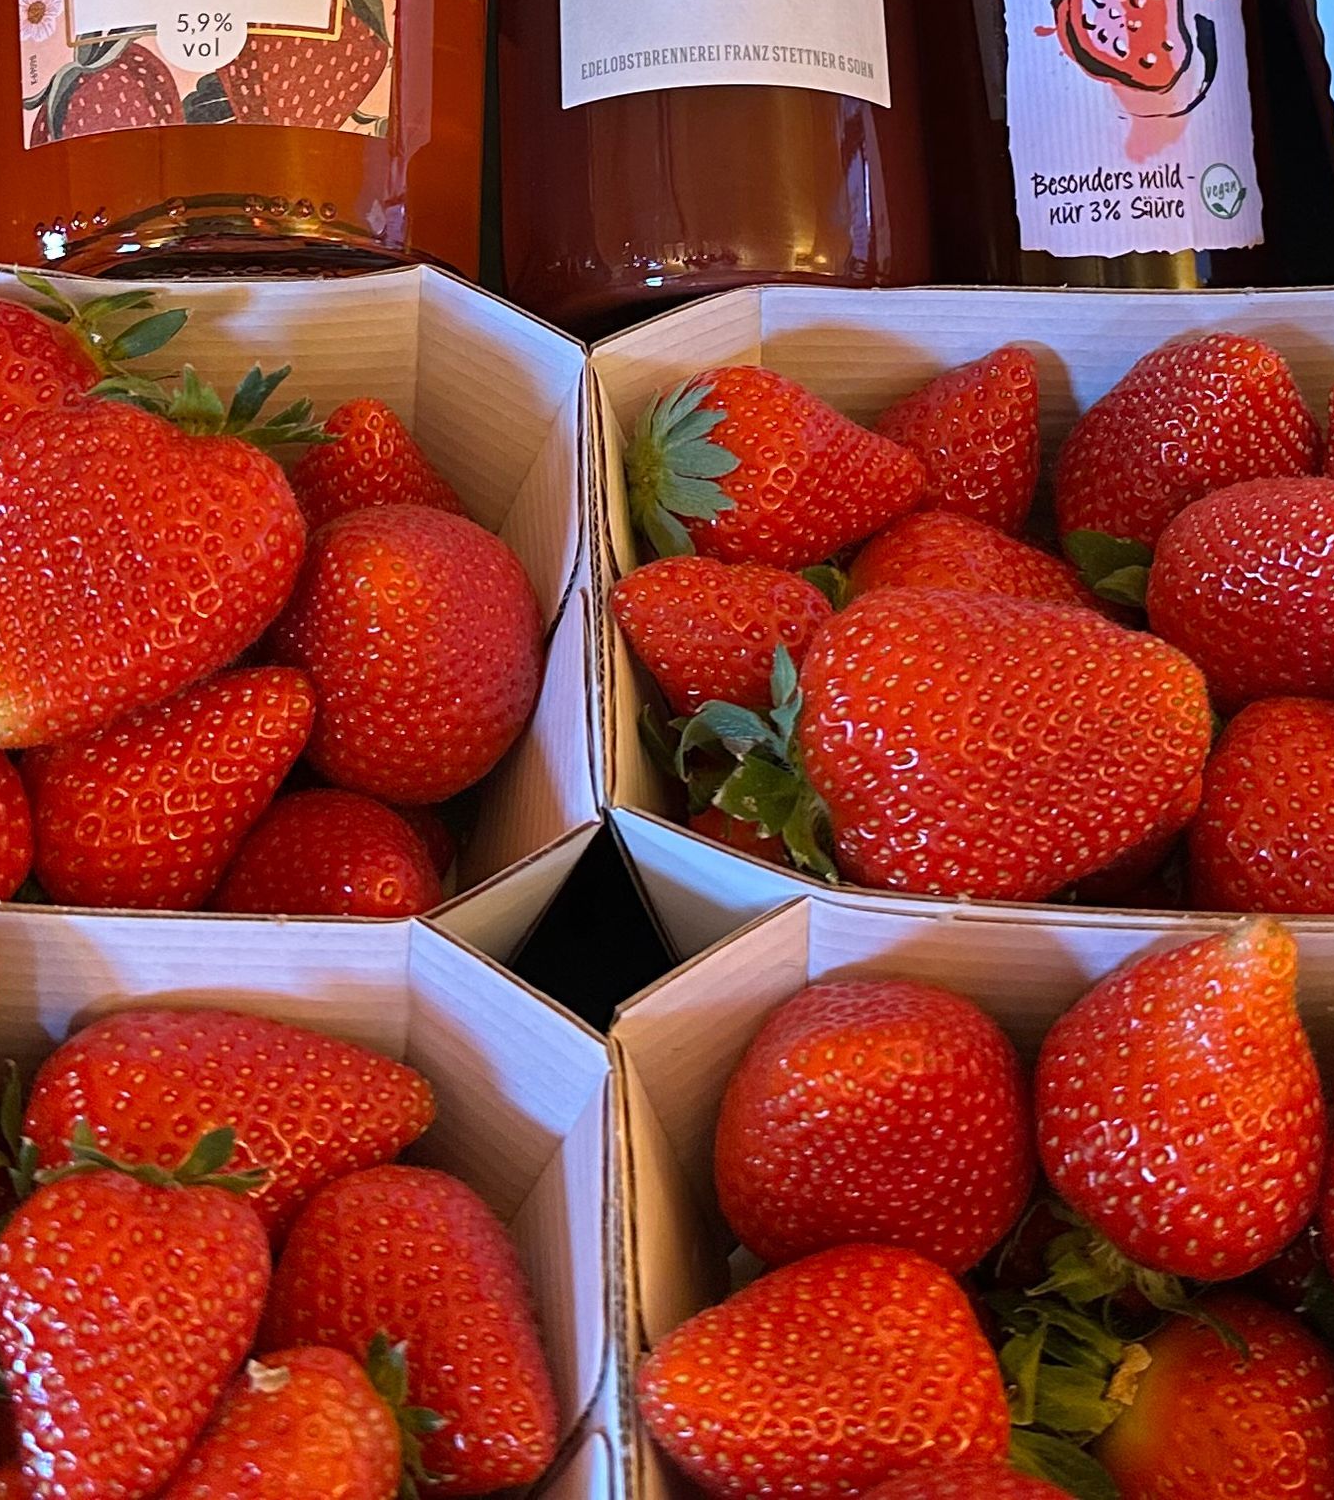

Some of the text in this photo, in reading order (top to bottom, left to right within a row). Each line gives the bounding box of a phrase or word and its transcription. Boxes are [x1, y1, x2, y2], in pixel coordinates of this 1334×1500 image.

[176, 12, 233, 35] 5,9%
[182, 37, 220, 57] vol
[581, 44, 874, 80] EDELOBSTBRENNEREI FRANZ STETTNER & SOHN
[1030, 166, 1134, 198] Besonders
[1138, 162, 1184, 189] mild
[1205, 179, 1238, 199] vegan
[1090, 199, 1121, 223] 3%
